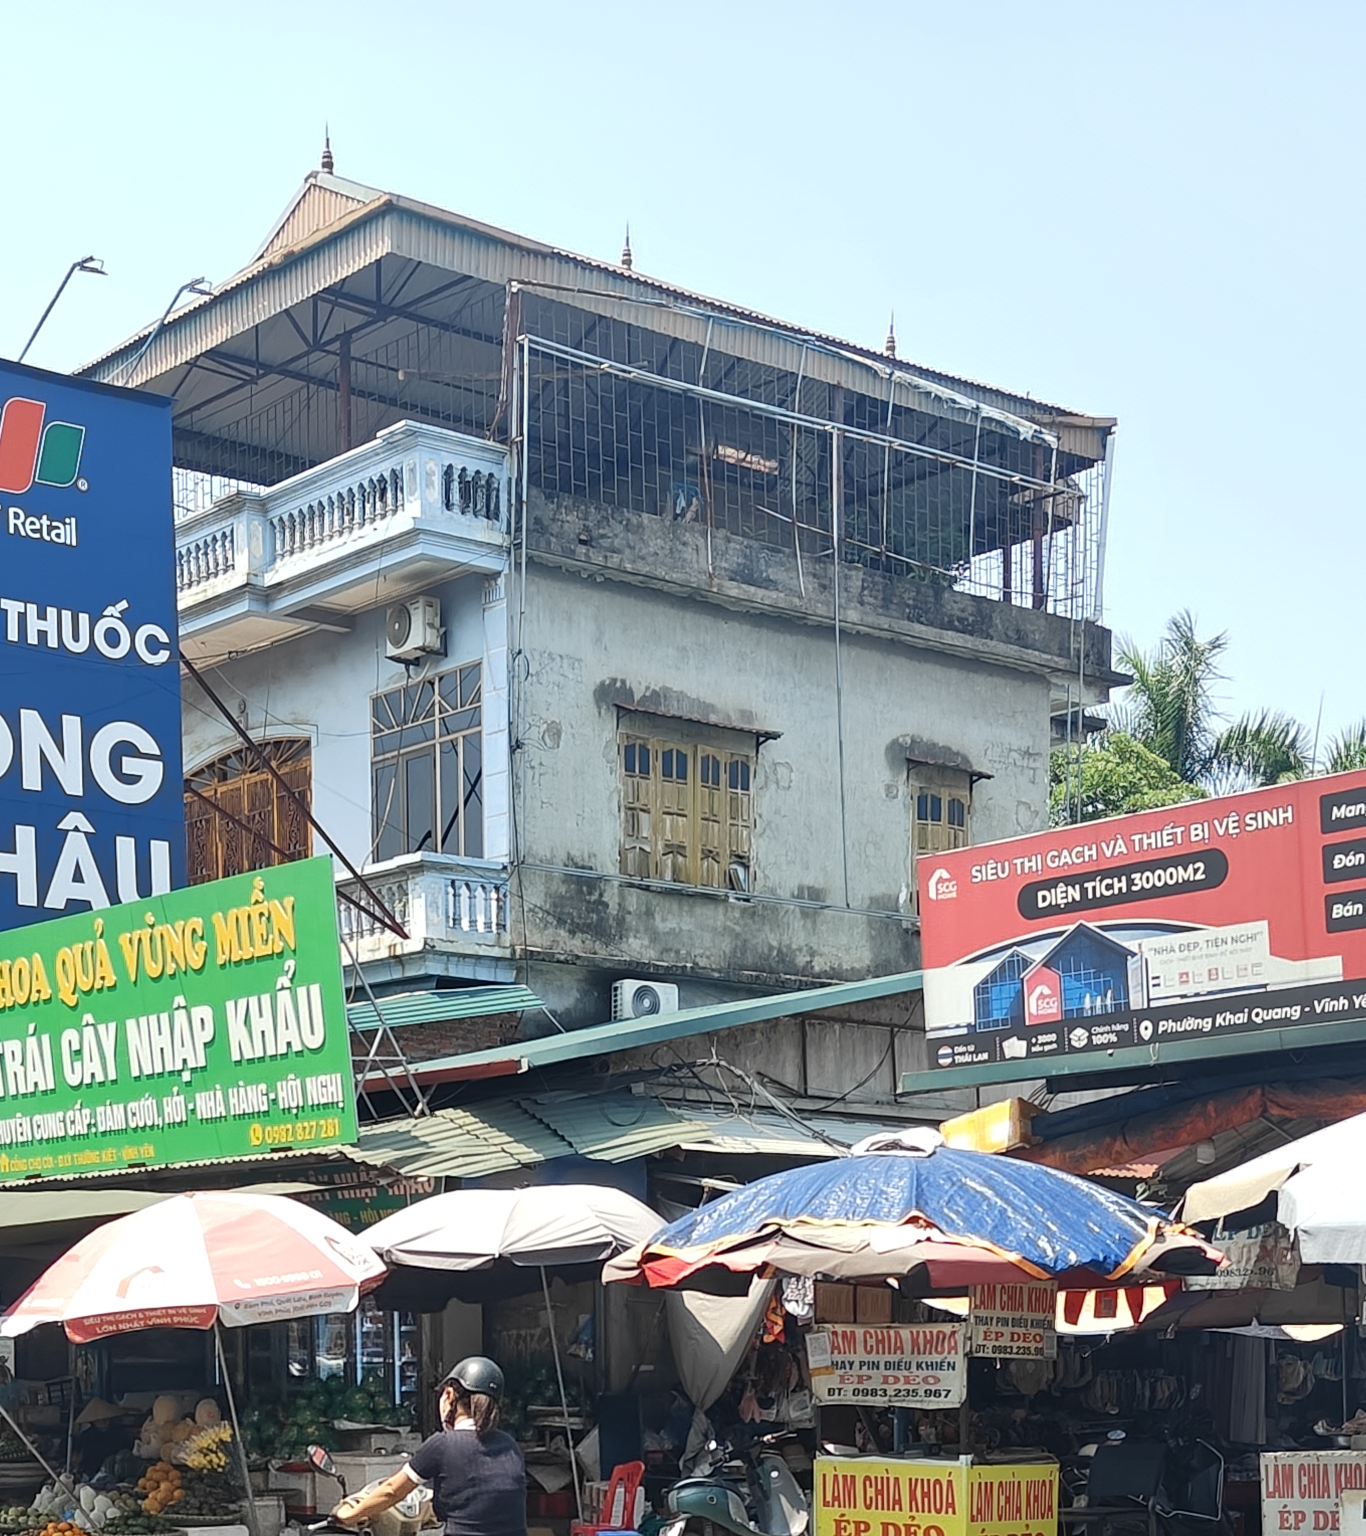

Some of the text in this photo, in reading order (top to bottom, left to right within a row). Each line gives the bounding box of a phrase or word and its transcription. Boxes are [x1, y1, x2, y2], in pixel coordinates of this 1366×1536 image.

[8, 507, 76, 547] Retail
[0, 599, 171, 666] THUỐC
[971, 806, 1294, 883] SIÊU THỊ GẠCH VÀ THIẾT BỊ VỆ SINH
[1333, 851, 1365, 869] Đón
[937, 878, 957, 895] SCG
[1037, 862, 1206, 909] DIỆN TÍCH 3000M2
[1332, 900, 1364, 920] Bán
[55, 917, 116, 1006] QUẢ
[119, 912, 207, 982] VÙNG
[211, 876, 296, 966] MIỀN
[61, 1013, 117, 1088] CÂY
[126, 995, 214, 1082] NHẬP
[225, 959, 325, 1062] KHẨU
[1157, 1015, 1212, 1037] Phường
[1215, 1007, 1249, 1026] Khai
[1251, 1002, 1301, 1026] Quang
[1313, 996, 1349, 1015] Vĩnh
[1092, 1033, 1118, 1045] 100%
[33, 1110, 64, 1141] CUNG
[66, 1099, 96, 1137] CẤP:
[96, 1099, 126, 1132] ĐÁM
[127, 1093, 162, 1129] CƯỚI,
[164, 1086, 187, 1123] HỎI
[195, 1085, 226, 1120] NHÀ
[228, 1080, 269, 1115] HÀNG
[277, 1074, 302, 1114] HỘI
[306, 1073, 344, 1108] NGHỊ
[265, 1118, 340, 1145] 0982 827 281
[974, 1315, 994, 1327] THAY
[996, 1317, 1010, 1328] PIN
[1012, 1314, 1029, 1329] ĐIỀU
[983, 1329, 1005, 1342] ÉP
[909, 1325, 959, 1355] KHOÁ
[838, 1371, 941, 1386] ÉP DẺO
[859, 1356, 956, 1372] PIN ĐIỀU KHIỂN
[827, 1387, 952, 1399] ĐT: 0983.235.967
[822, 1467, 956, 1515] LÀM CHÌA KHOÁ
[1265, 1456, 1294, 1499] LÀM
[1298, 1456, 1331, 1499] CHÌA
[971, 1471, 1053, 1523] LÀM CHÌA KHOÁ
[1278, 1504, 1306, 1530] ÉP
